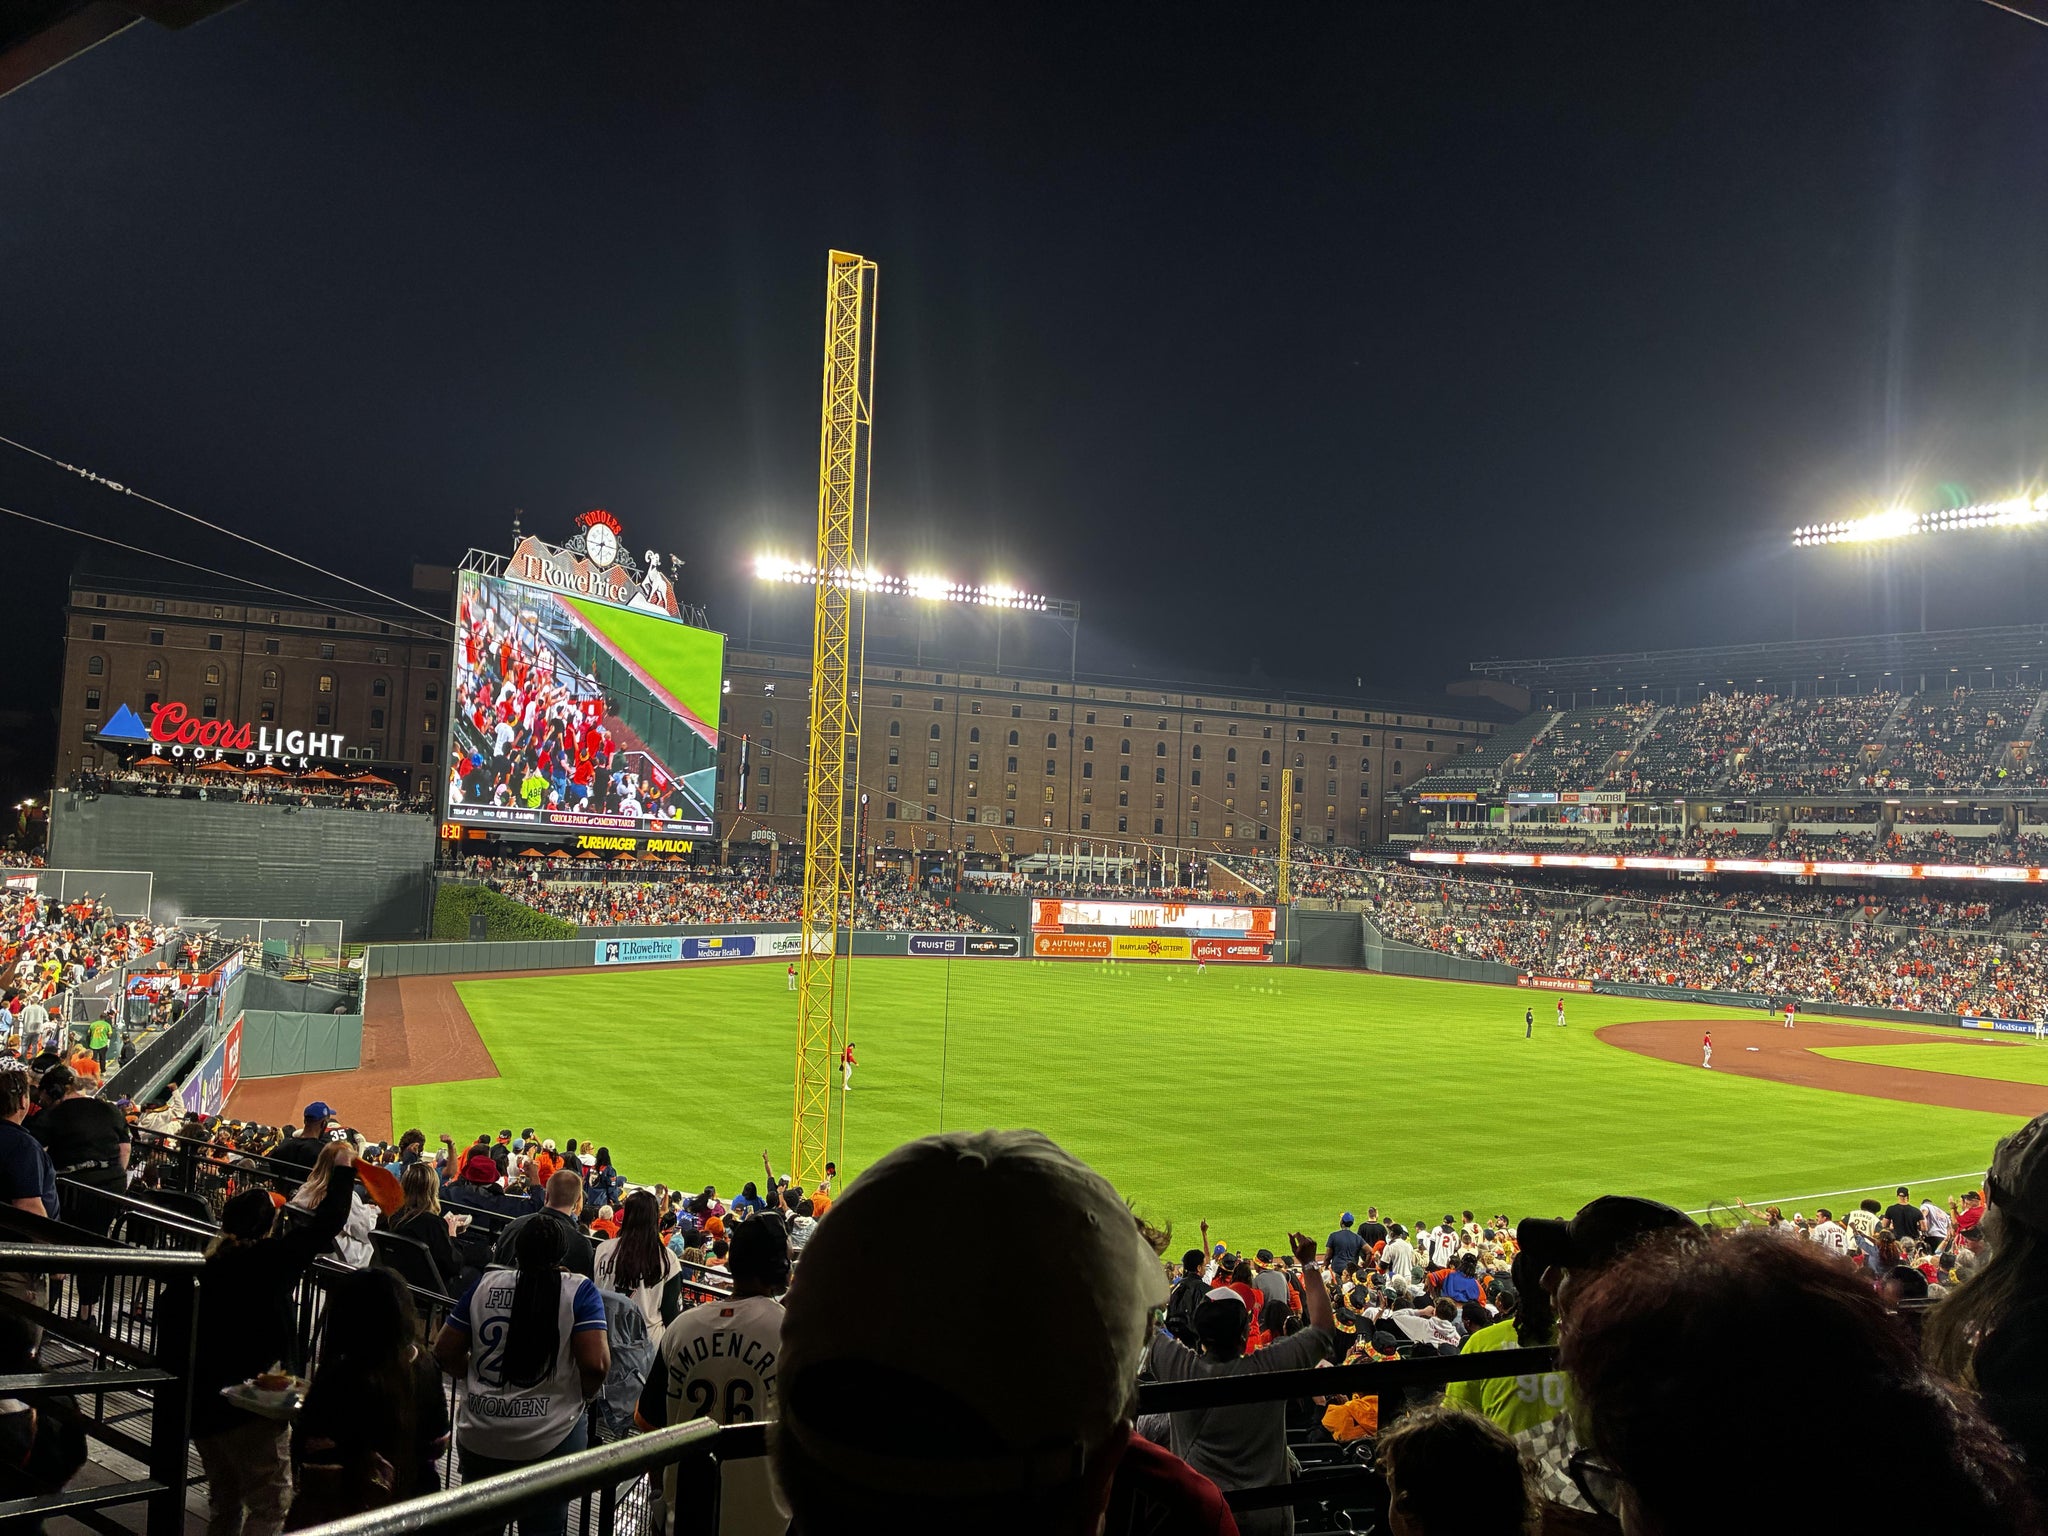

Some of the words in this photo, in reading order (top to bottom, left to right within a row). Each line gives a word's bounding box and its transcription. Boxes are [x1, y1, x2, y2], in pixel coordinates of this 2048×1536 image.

[585, 510, 622, 535] ORIOLES
[151, 702, 254, 750] Coors
[258, 726, 345, 758] LIGHT
[152, 743, 224, 761] ROOF
[246, 752, 309, 769] DECK
[1595, 793, 1622, 802] AMBI
[550, 813, 573, 822] ORIOLE
[572, 815, 588, 825] PARK
[593, 817, 618, 827] CAMDEN
[617, 819, 636, 828] YARDS
[441, 823, 461, 839] 0:30
[646, 838, 693, 854] PAVILION
[1130, 909, 1160, 928] HOME
[916, 941, 945, 949] TRUIST
[1052, 940, 1085, 948] AUTUMN
[1087, 941, 1107, 949] LAKE
[1119, 943, 1148, 951] MARYLAND
[1159, 944, 1184, 952] LOTTERY
[1197, 946, 1222, 957] HIGH'S
[697, 948, 721, 958] MedStar
[721, 947, 741, 957] Health
[1539, 979, 1575, 989] markets
[1995, 1023, 2028, 1032] MedStar
[329, 1128, 348, 1142] 35
[1442, 1235, 1451, 1248] 2
[1835, 1233, 1844, 1248] 2
[468, 1392, 551, 1418] WOMEN
